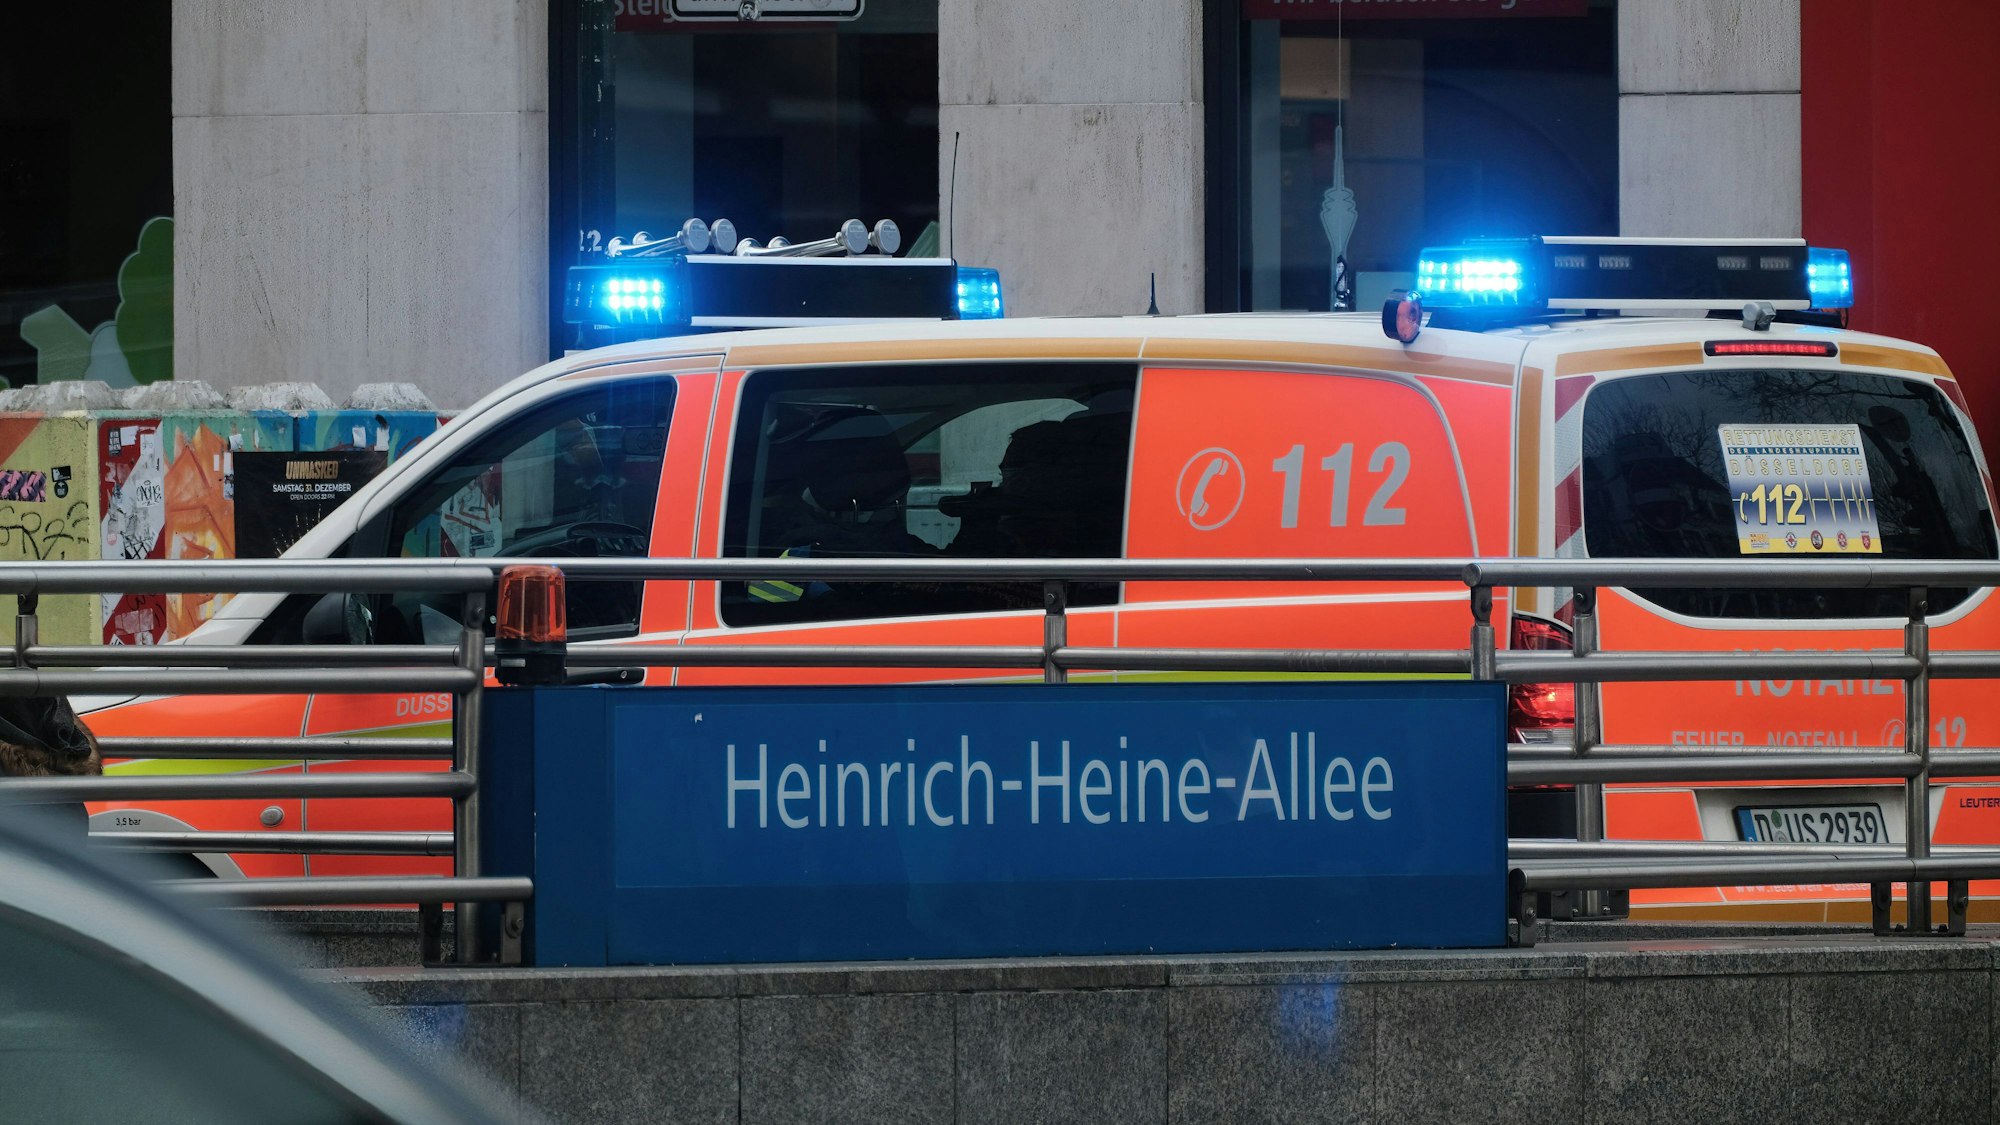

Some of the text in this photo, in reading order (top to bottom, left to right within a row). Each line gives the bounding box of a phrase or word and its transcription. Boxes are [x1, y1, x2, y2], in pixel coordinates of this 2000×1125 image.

[1723, 429, 1856, 446] RETTUNGSDIENST
[1729, 447, 1859, 455] DER LANDESHAUPTSTADT
[285, 461, 339, 480] UNMASKED
[1729, 455, 1864, 476] DÜSSELDORF
[272, 484, 304, 493] SAMSTAG
[314, 483, 352, 492] DEZEMBER
[1271, 441, 1411, 529] 112
[1751, 484, 1806, 525] 112
[726, 731, 1394, 829] Heinrich-Heine-Allee
[115, 817, 141, 827] 3,5 bar
